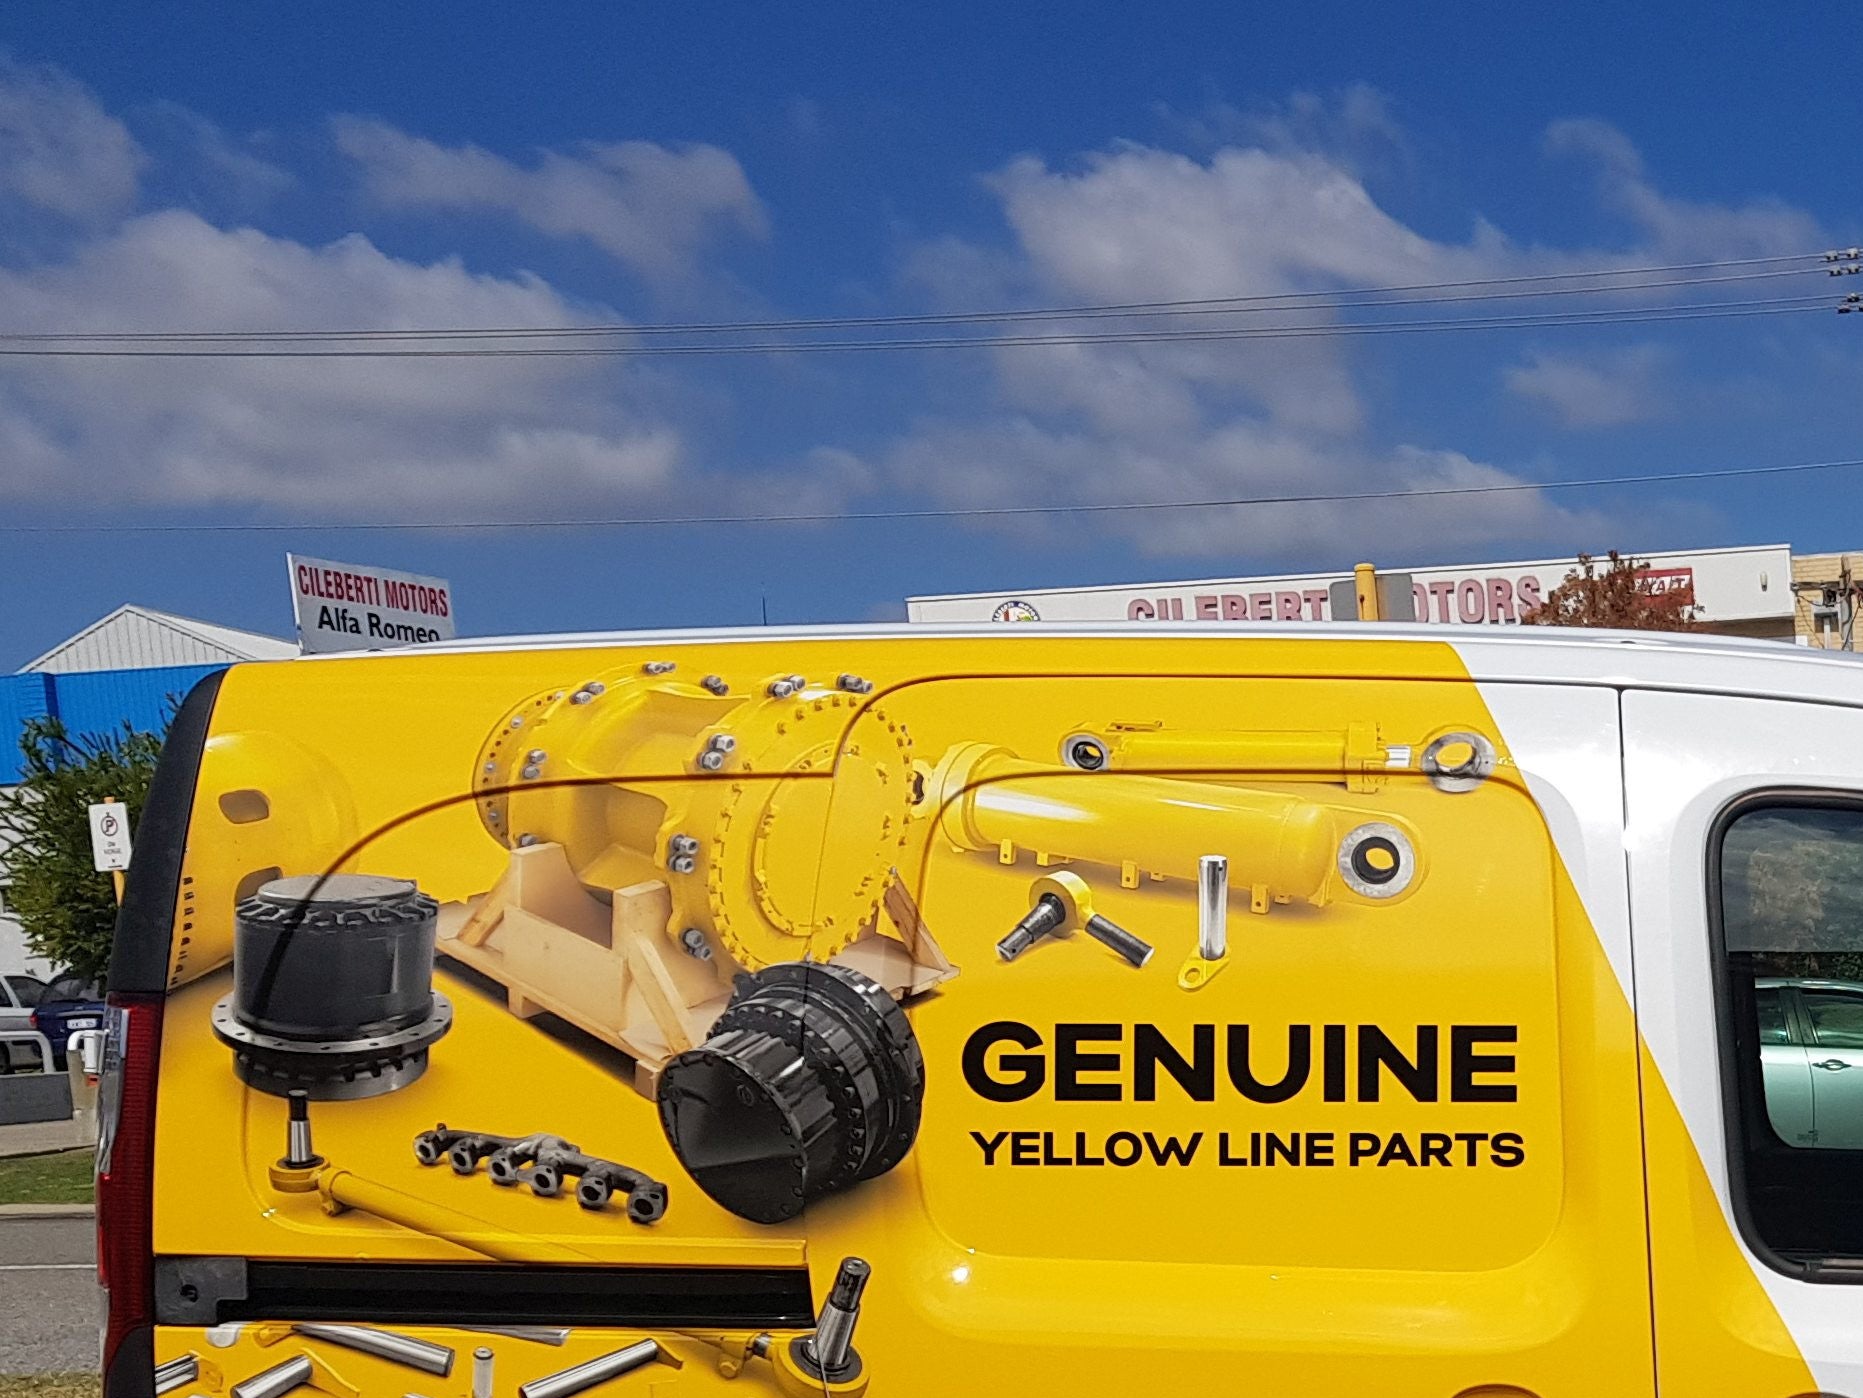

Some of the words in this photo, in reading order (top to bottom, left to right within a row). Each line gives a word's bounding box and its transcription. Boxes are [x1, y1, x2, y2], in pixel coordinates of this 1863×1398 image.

[298, 565, 380, 606] CILEBERTI
[384, 579, 449, 617] MOTORS
[318, 605, 361, 634] Alfa
[367, 612, 440, 643] Romeo
[962, 1021, 1519, 1105] GENUINE
[970, 1131, 1205, 1168] YELLOW
[1219, 1132, 1336, 1168] LINE
[1350, 1132, 1526, 1169] PARTS
